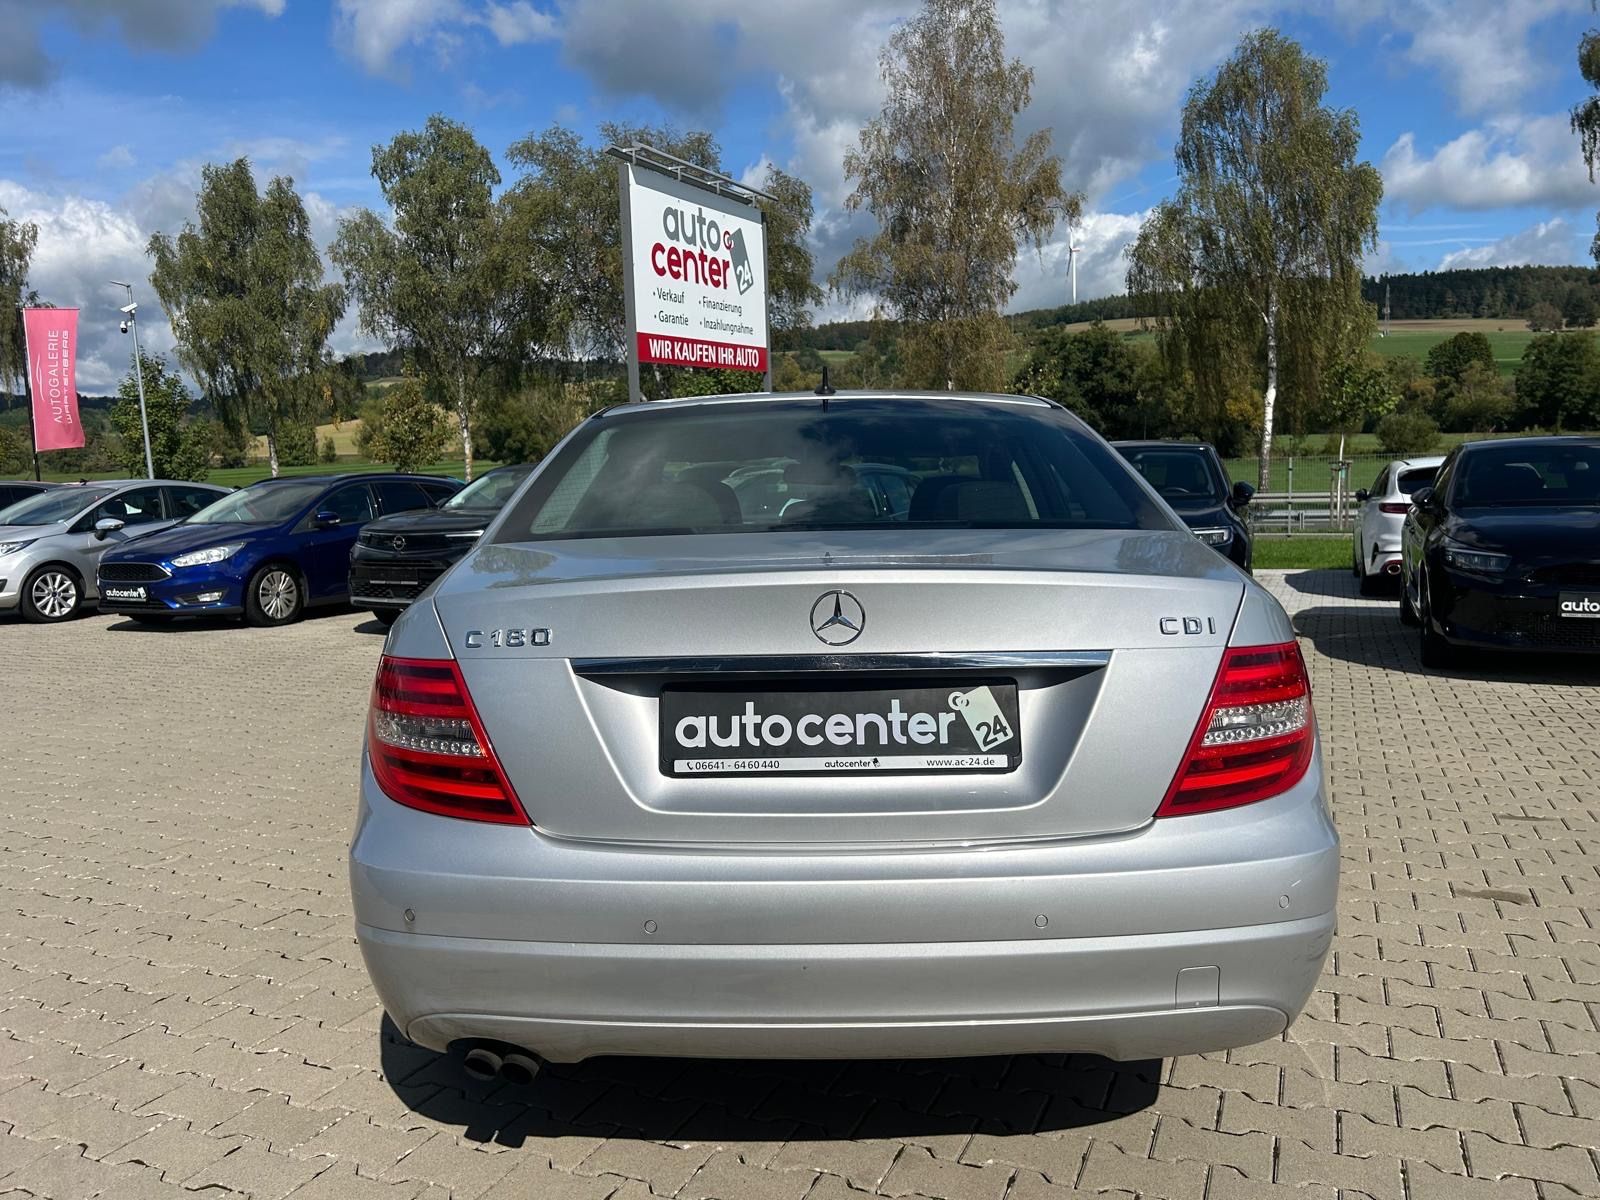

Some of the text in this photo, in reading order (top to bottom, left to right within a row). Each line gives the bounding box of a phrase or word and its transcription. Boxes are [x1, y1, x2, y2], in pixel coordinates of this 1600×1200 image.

[663, 206, 721, 252] auto
[651, 242, 730, 290] center
[736, 263, 753, 291] 24
[656, 287, 685, 304] Verkauf
[702, 296, 743, 317] Finanzierung
[658, 310, 689, 326] Garantie
[703, 317, 754, 335] Inzahlungnahme
[648, 338, 760, 367] WIR KAUFEN IHR AUTO
[48, 330, 63, 423] AUTOGALERIE
[105, 588, 139, 597] autocenter
[1561, 597, 1600, 612] auto
[1159, 616, 1217, 635] CDI
[465, 626, 553, 648] C 180
[675, 701, 955, 747] autocenter
[975, 715, 1009, 747] 24
[824, 760, 871, 768] autocenter
[926, 757, 995, 767] www.ac-24.de
